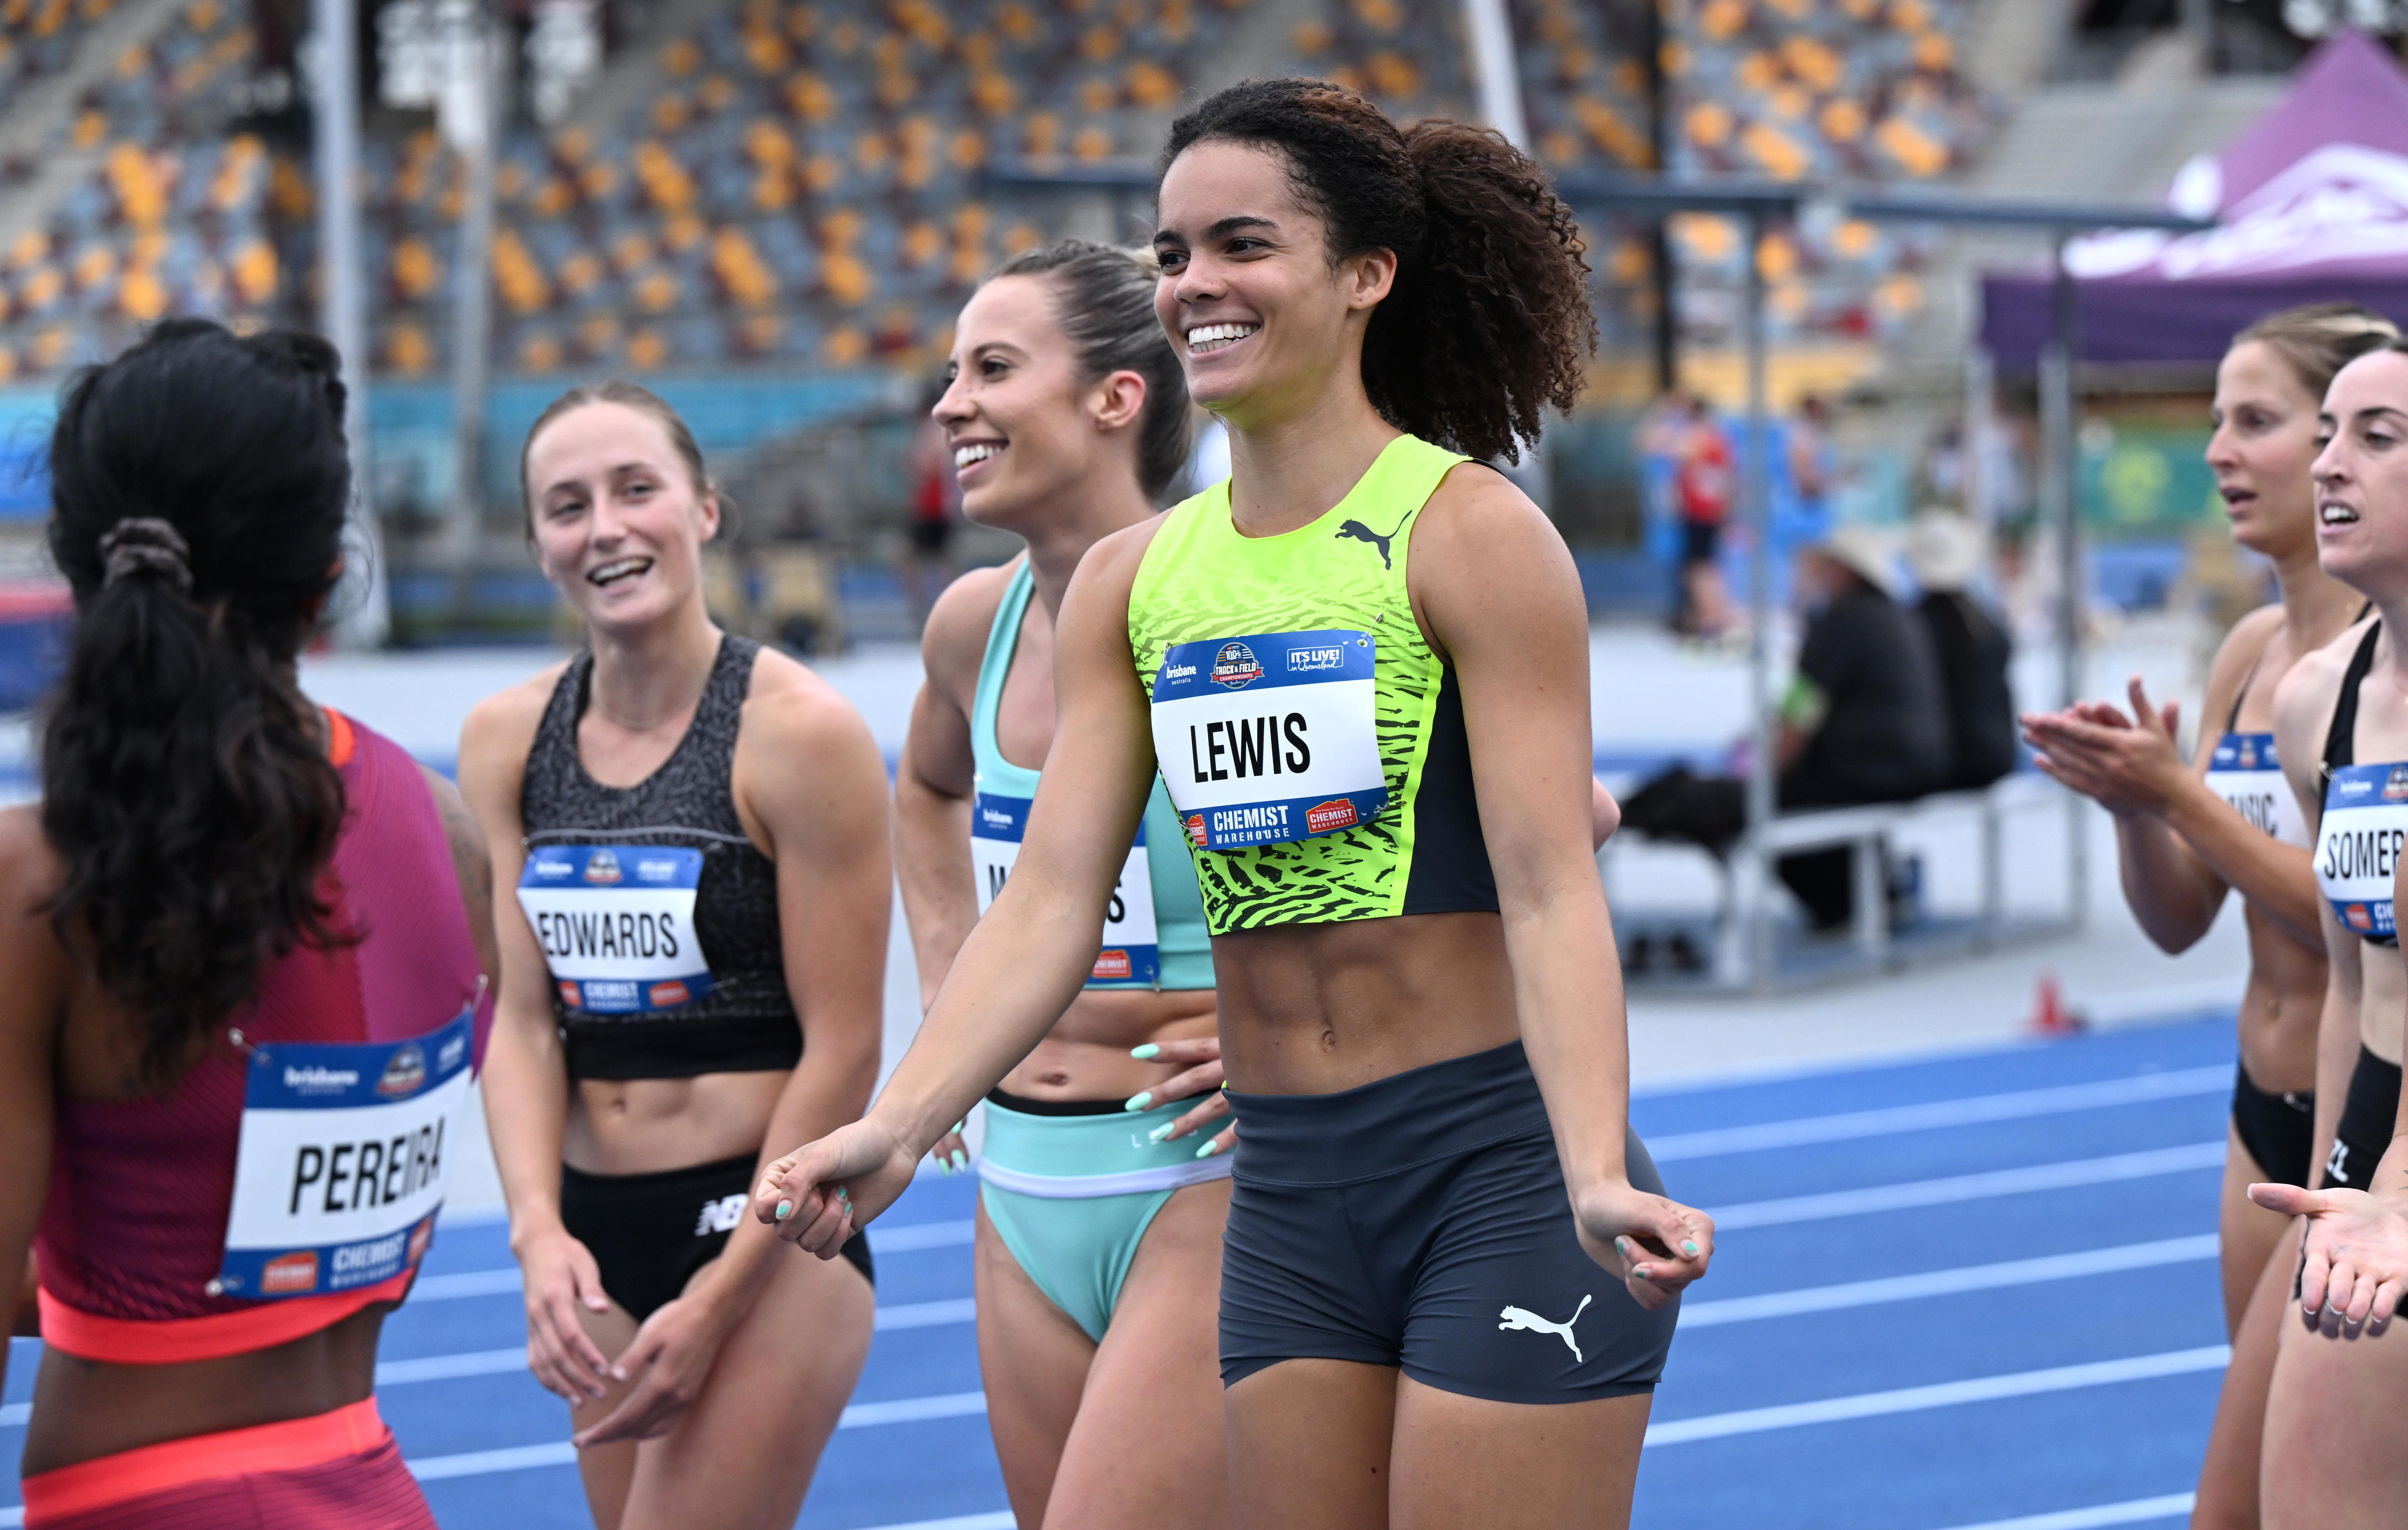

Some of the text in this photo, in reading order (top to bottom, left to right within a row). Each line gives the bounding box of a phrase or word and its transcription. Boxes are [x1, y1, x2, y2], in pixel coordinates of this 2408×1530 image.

[1291, 649, 1339, 663] IT'S LIVE!
[1166, 664, 1196, 679] brisbane
[1215, 665, 1234, 676] TRACK
[1239, 662, 1256, 673] FIELD
[1298, 658, 1336, 671] Queensland
[1219, 673, 1253, 682] CHAMPIONSHIPS
[1190, 712, 1311, 783] LEWIS
[1214, 805, 1288, 832] CHEMIST
[1310, 808, 1352, 823] CHEMIST
[1312, 818, 1353, 829] WAREHOUSE
[1216, 828, 1290, 844] WAREHOUSE
[537, 911, 679, 958] EDWARDS
